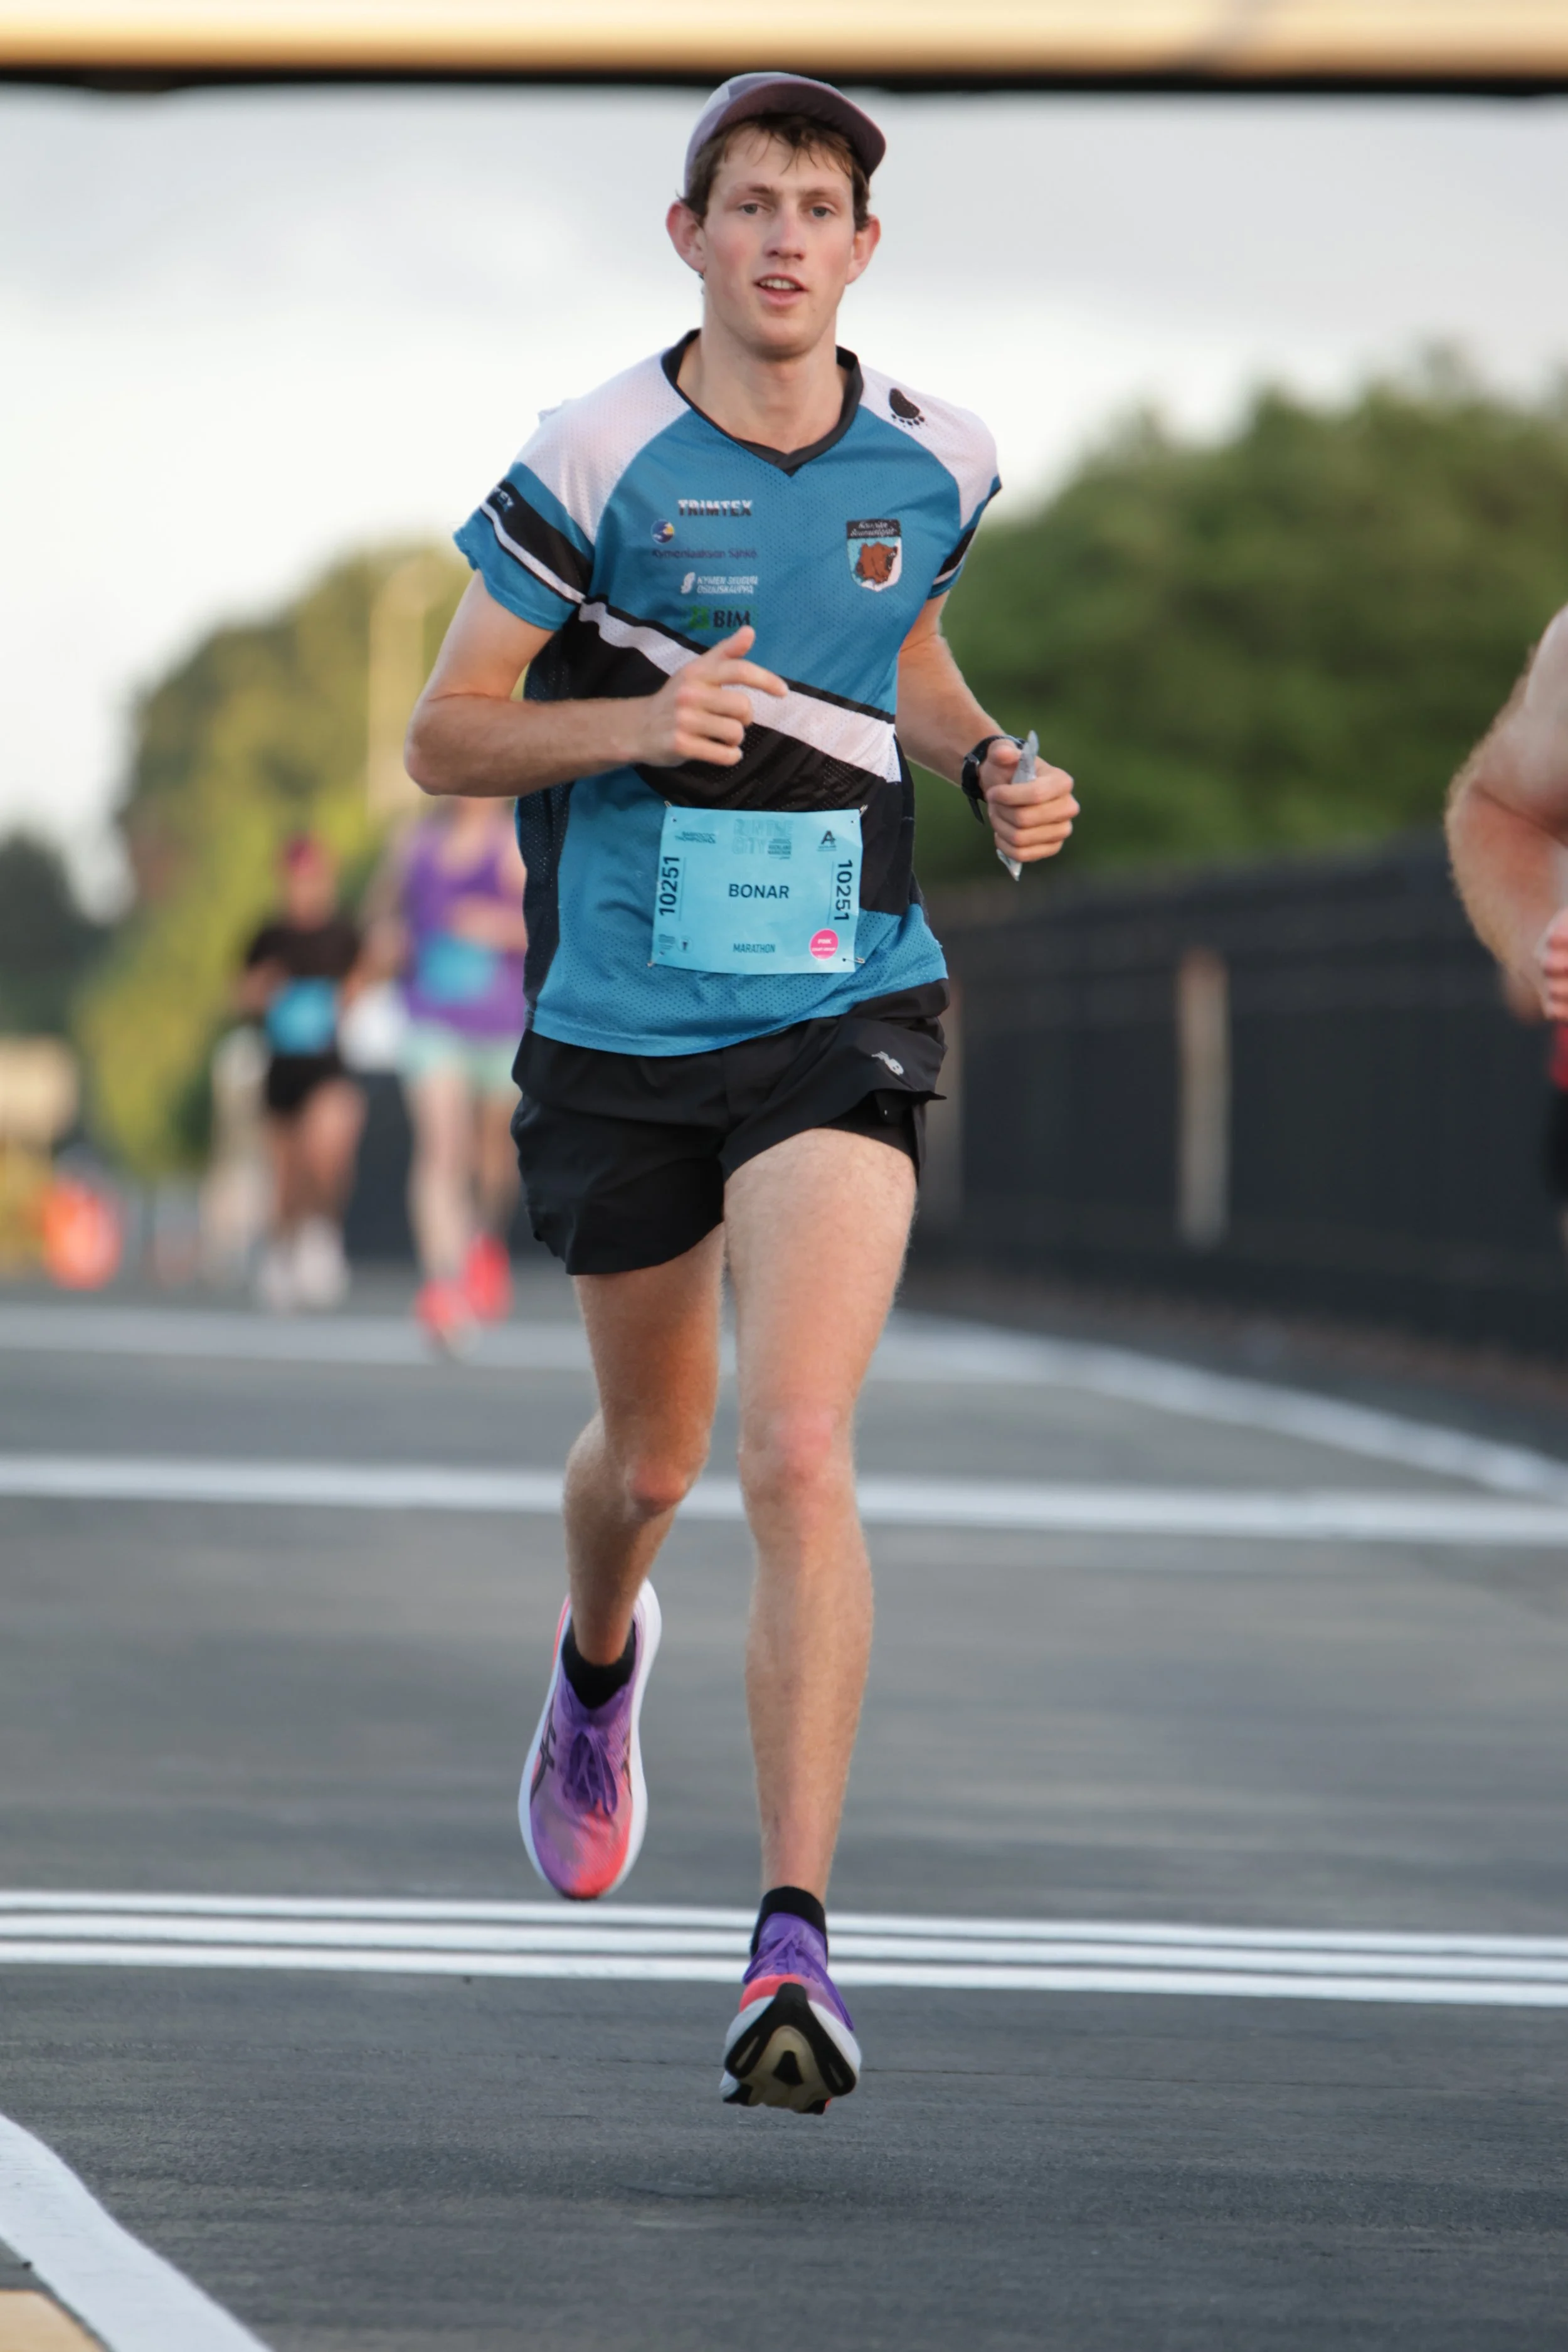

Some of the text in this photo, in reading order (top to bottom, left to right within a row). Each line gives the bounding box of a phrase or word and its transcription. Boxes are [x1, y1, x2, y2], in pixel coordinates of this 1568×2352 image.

[678, 499, 752, 516] TRIMTEX
[713, 610, 750, 628] BIM
[659, 856, 680, 916] 10251
[729, 884, 790, 899] BONAR
[834, 859, 853, 920] 10251
[733, 943, 776, 953] MARATHON
